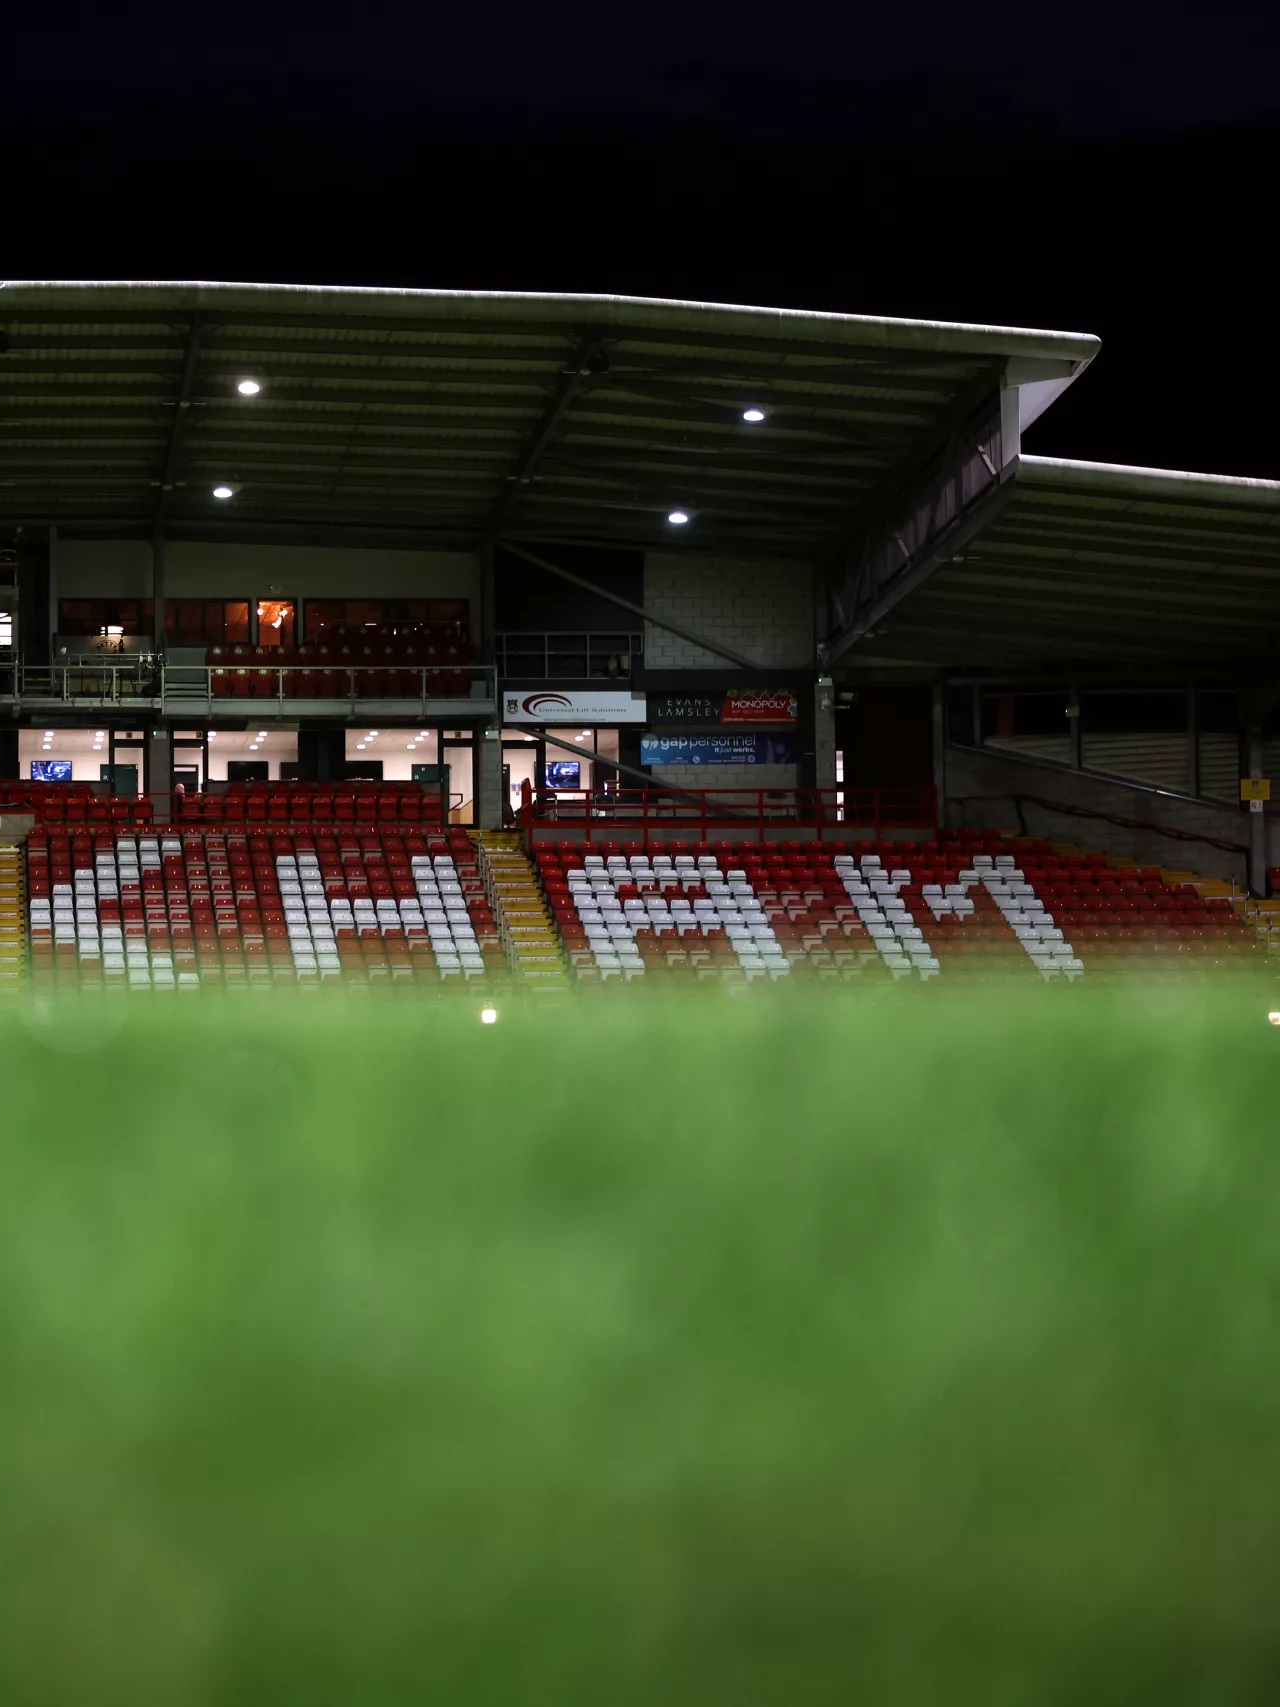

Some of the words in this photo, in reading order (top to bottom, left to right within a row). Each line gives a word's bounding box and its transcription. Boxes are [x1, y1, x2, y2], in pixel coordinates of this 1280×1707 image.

[667, 698, 711, 706] EVANS
[731, 700, 787, 709] MONOPOLY
[657, 708, 720, 717] LAMSLEY
[660, 736, 688, 750] gap
[689, 733, 756, 749] personnel
